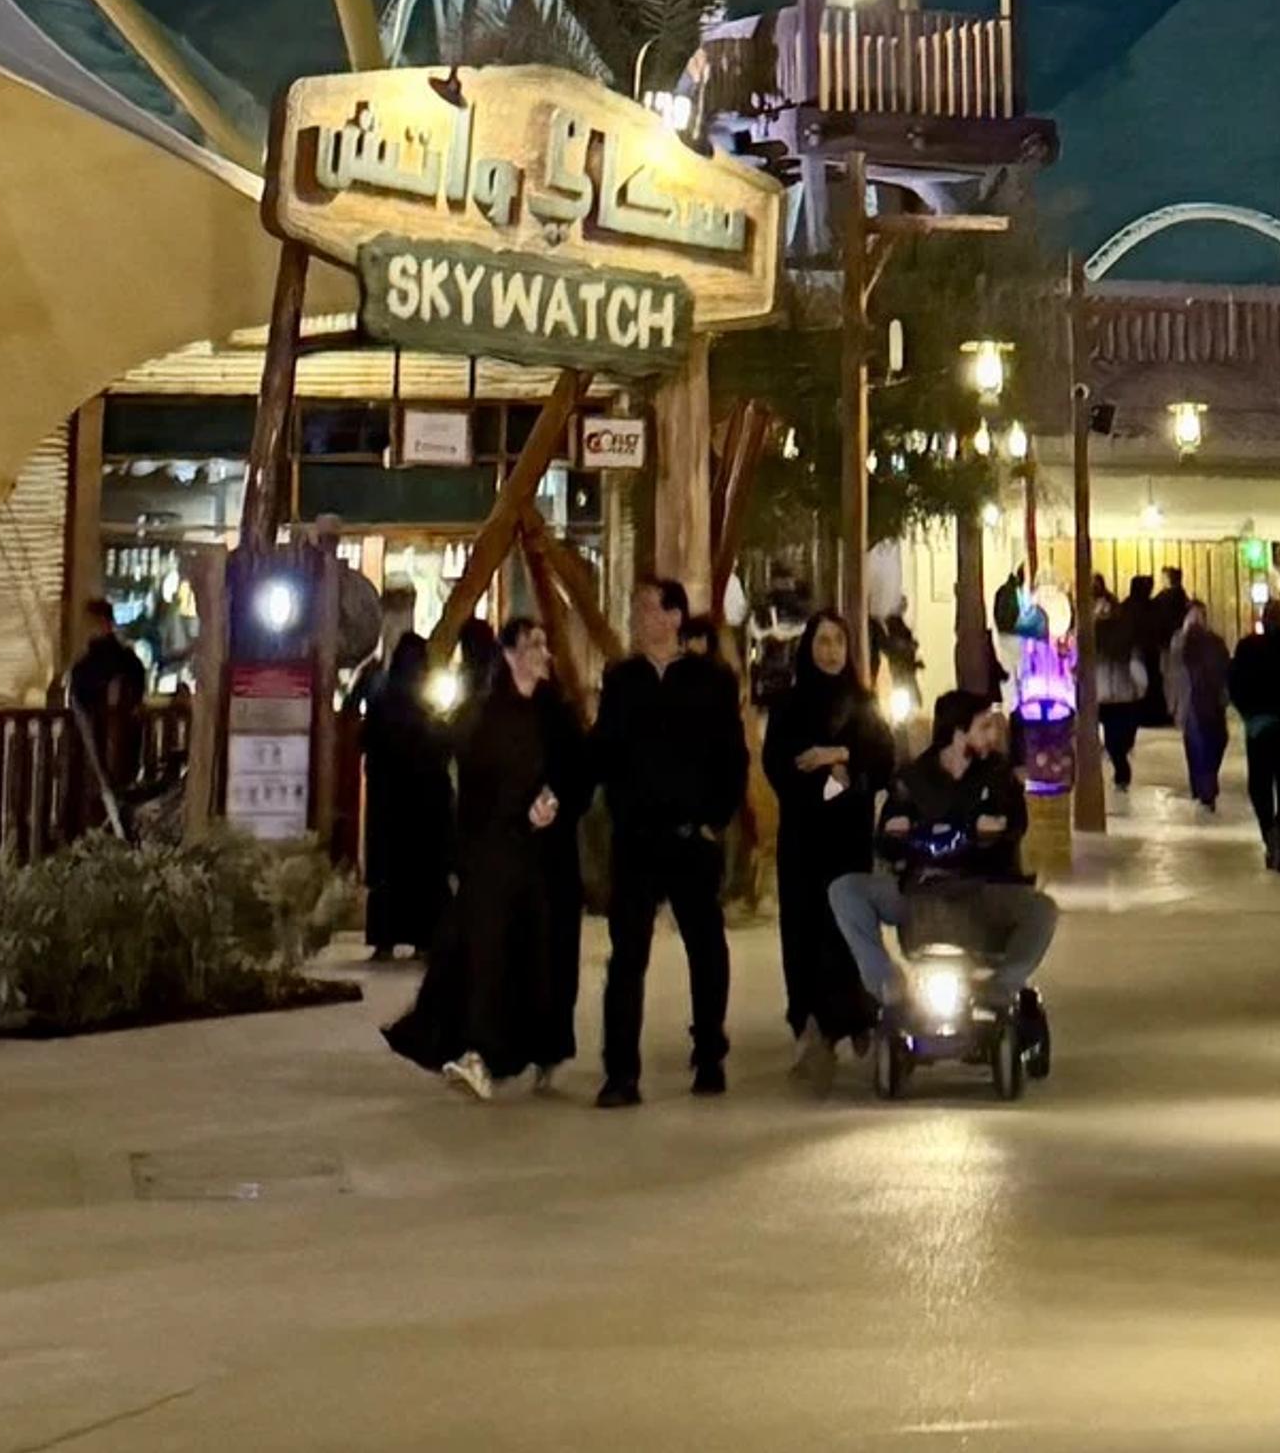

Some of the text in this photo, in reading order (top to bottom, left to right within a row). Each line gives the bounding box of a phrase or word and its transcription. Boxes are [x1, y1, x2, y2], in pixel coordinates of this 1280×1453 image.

[316, 101, 747, 251] سكاي واتش
[386, 255, 675, 349] SKYWATCH
